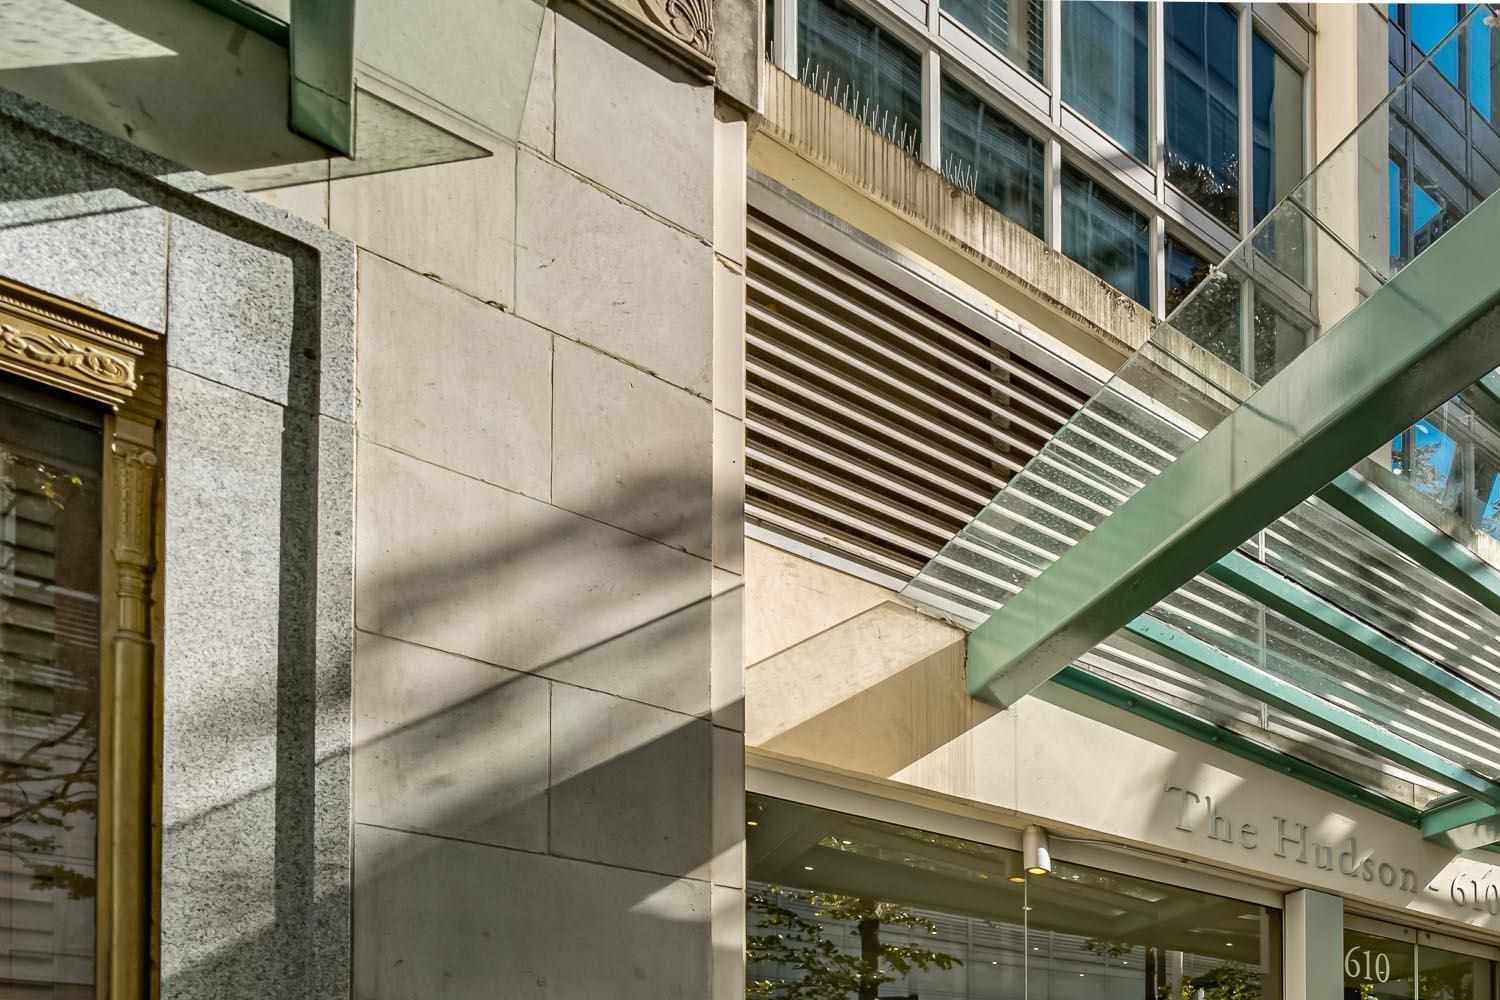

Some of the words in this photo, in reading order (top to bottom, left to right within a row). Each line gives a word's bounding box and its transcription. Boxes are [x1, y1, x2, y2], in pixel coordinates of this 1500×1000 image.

[1165, 785, 1259, 850] The
[1273, 815, 1419, 894] Hudson
[1449, 870, 1500, 918] 610
[1344, 945, 1390, 983] 610
